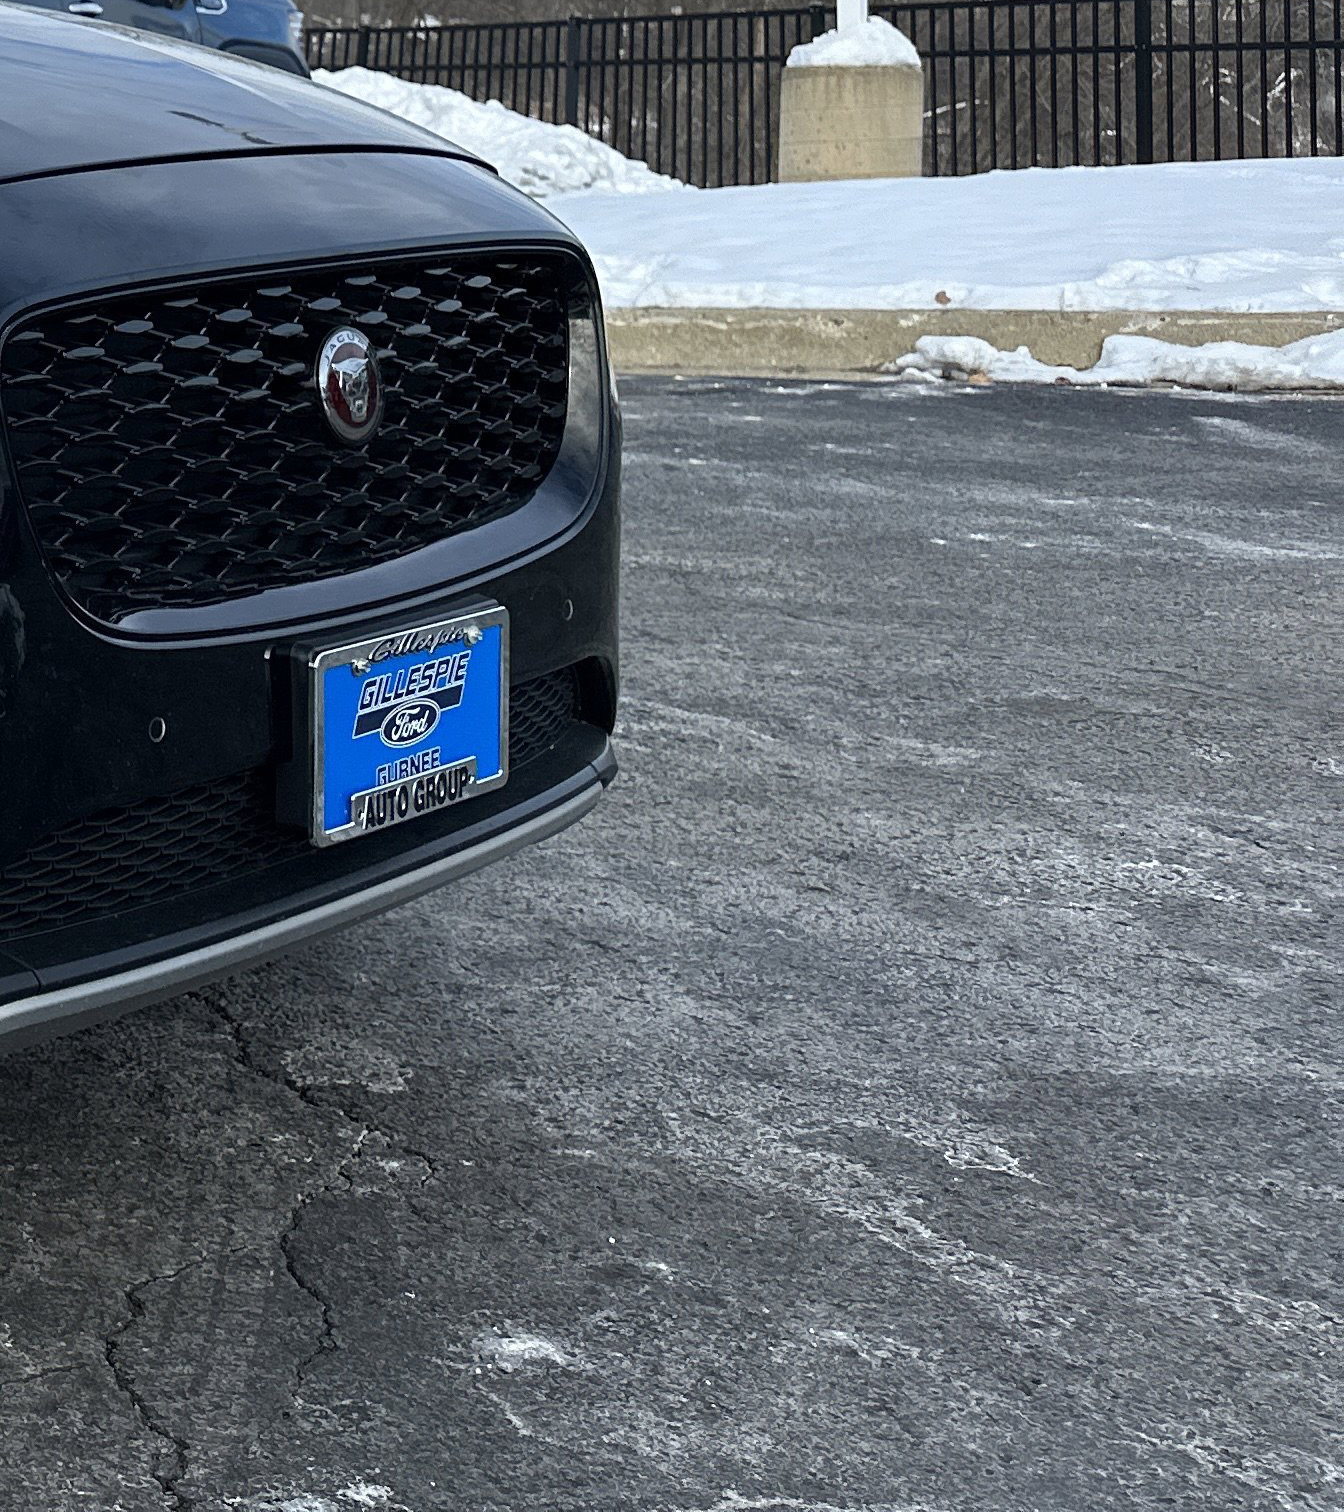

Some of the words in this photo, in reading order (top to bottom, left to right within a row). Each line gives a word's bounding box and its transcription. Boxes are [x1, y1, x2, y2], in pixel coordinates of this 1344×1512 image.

[359, 651, 471, 711] GILLESPIE
[391, 706, 430, 741] Ford
[376, 746, 441, 787] GURNEE
[362, 784, 409, 830] AUTO
[413, 766, 469, 813] GROUP
